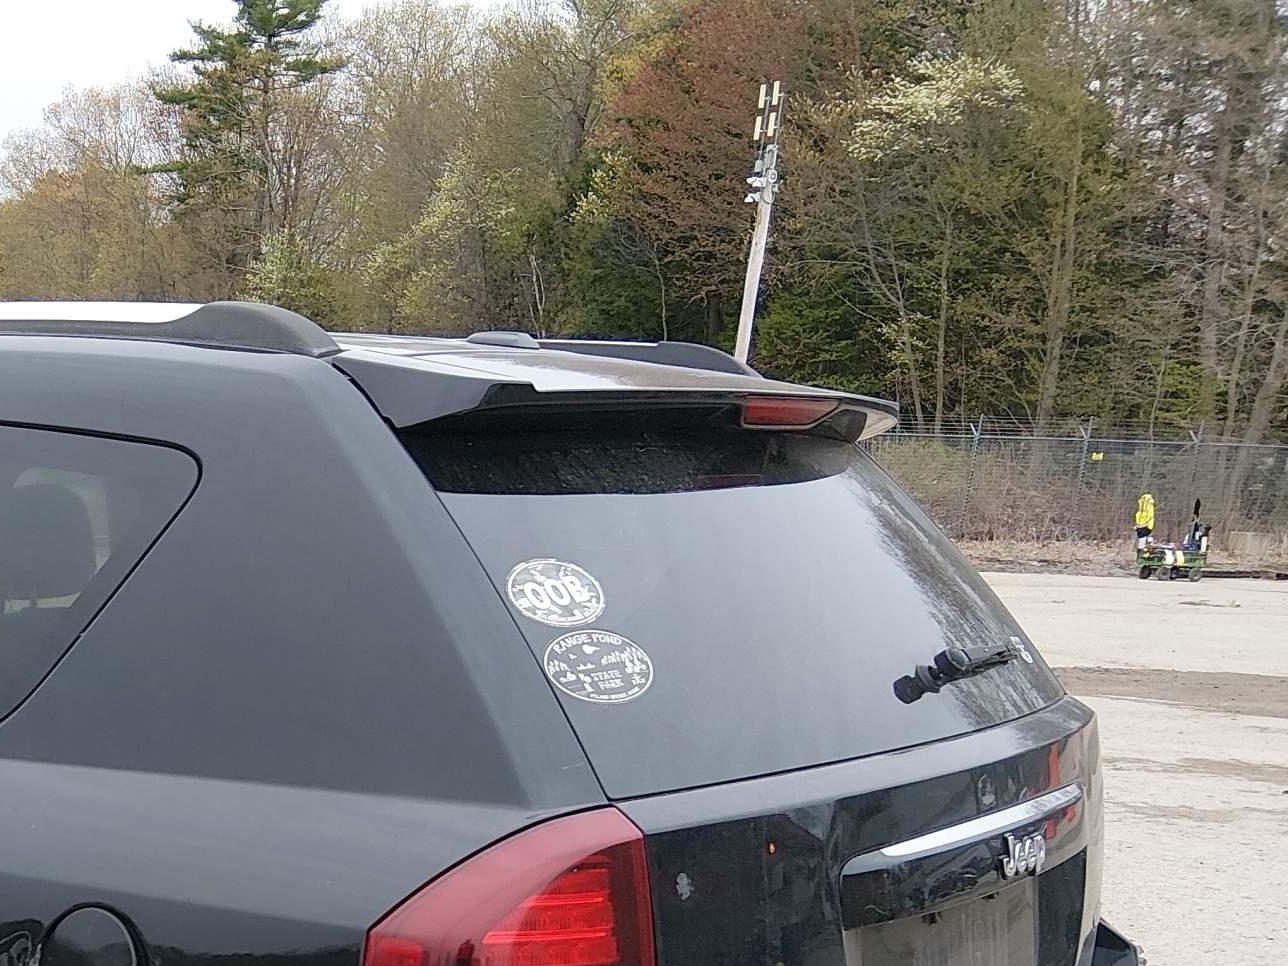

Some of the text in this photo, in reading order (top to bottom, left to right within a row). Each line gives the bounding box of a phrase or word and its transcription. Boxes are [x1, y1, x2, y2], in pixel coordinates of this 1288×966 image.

[552, 633, 623, 655] RANGE POND
[590, 670, 623, 682] STATE
[597, 679, 625, 691] PARK
[1000, 833, 1046, 877] Jeep
